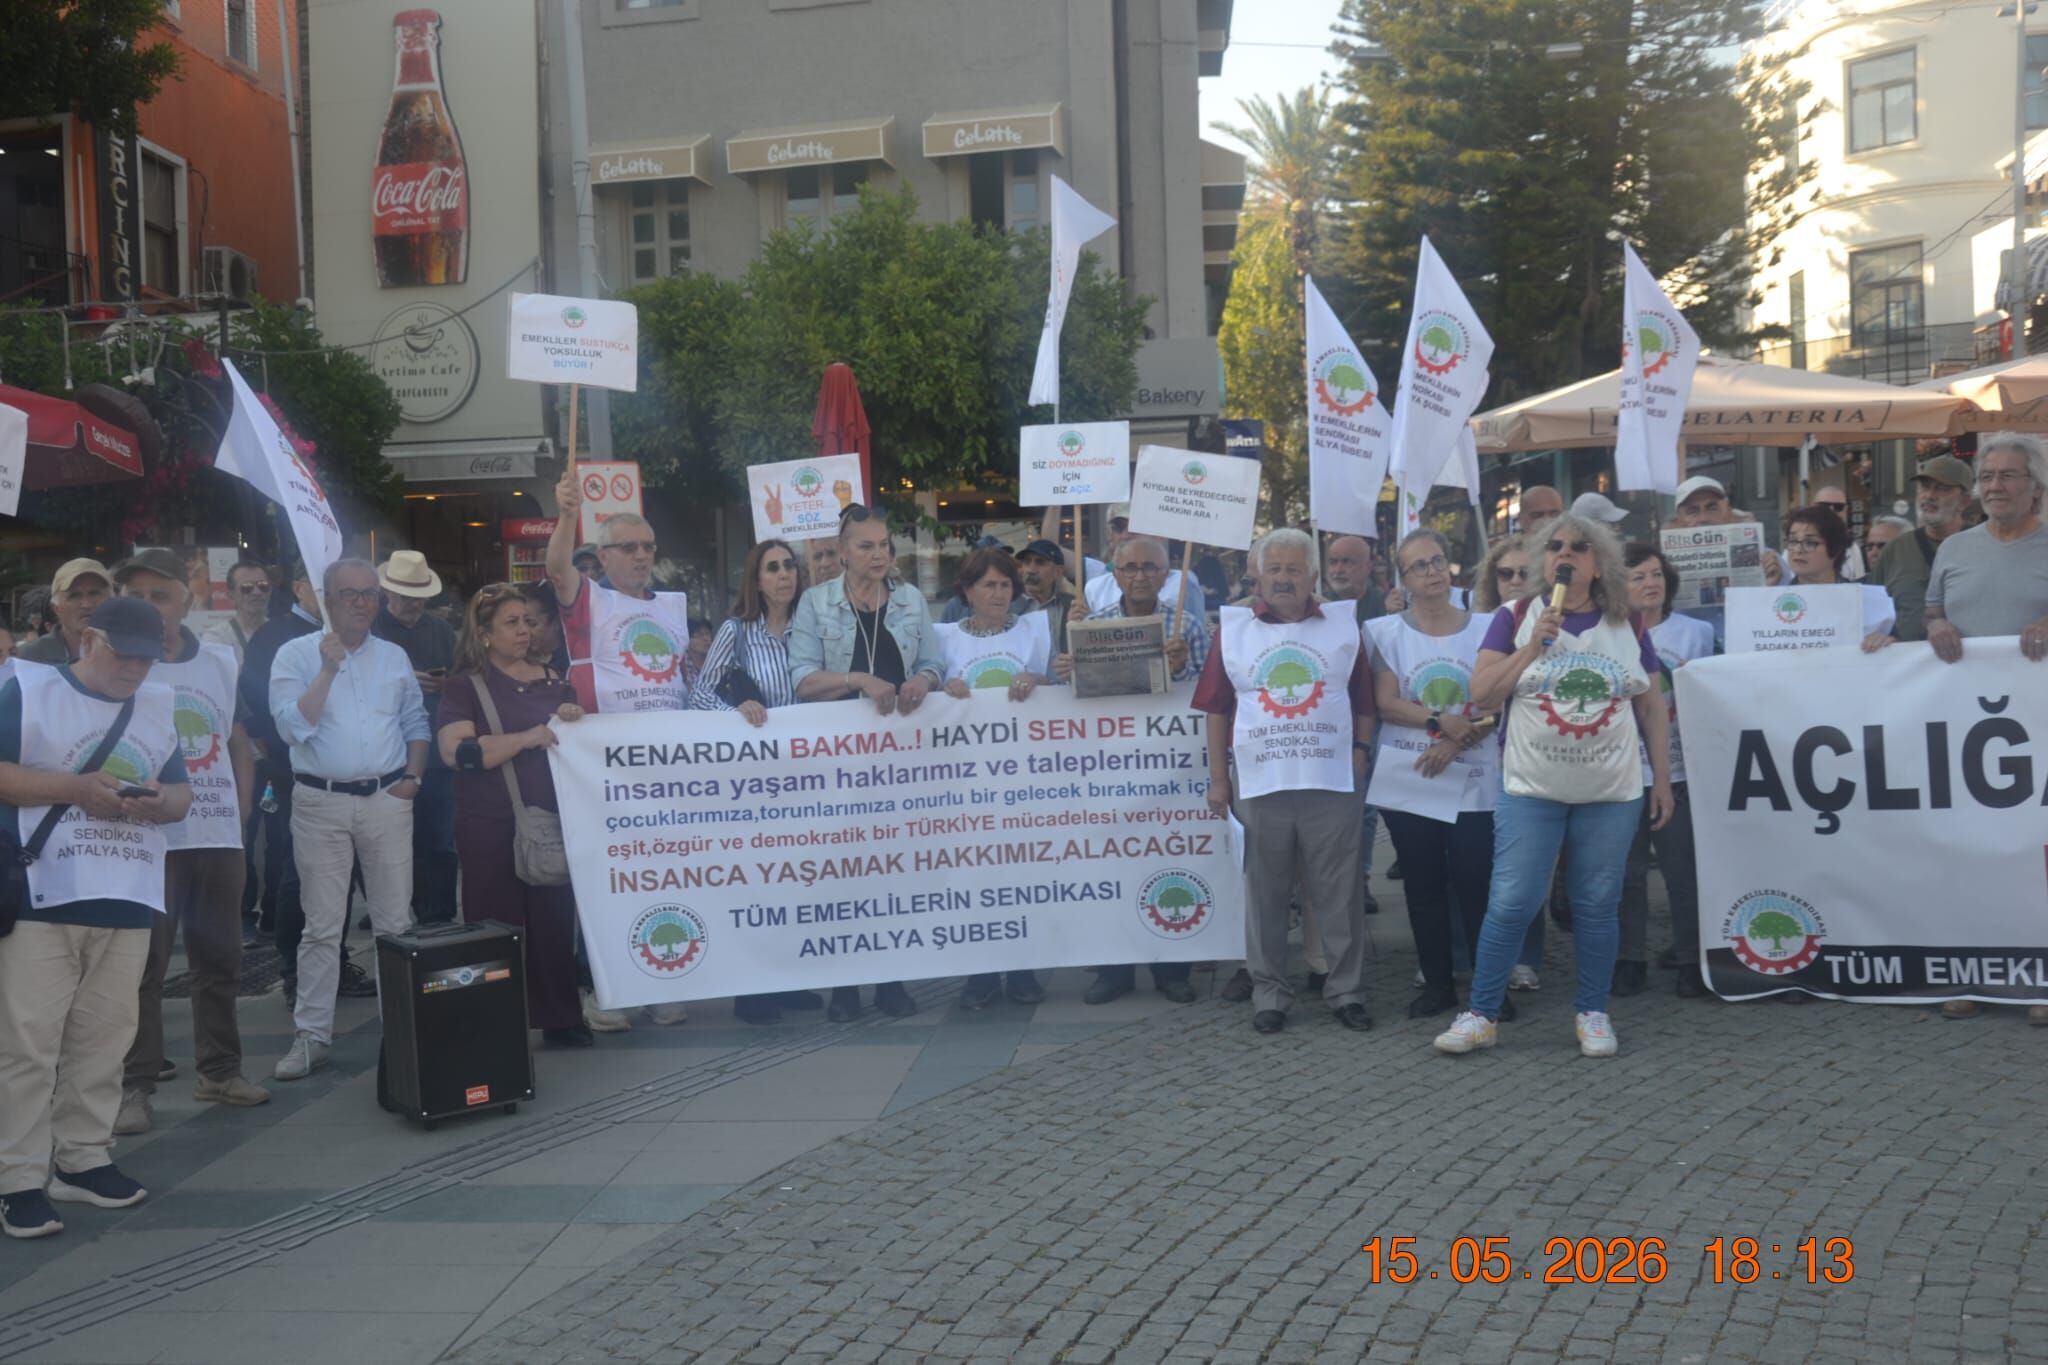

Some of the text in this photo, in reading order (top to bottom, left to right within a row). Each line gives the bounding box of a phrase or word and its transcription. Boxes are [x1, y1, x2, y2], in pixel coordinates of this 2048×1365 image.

[374, 167, 462, 216] Coca-Cola
[522, 334, 576, 346] EMEKLİLER
[544, 347, 602, 359] YOKSULLUK
[431, 363, 461, 376] Cafe
[1138, 388, 1205, 407] Bakery
[470, 455, 513, 474] Coca-Cola
[1062, 471, 1081, 482] İÇİN
[787, 499, 824, 512] YETER
[1164, 495, 1180, 505] GEL
[797, 512, 821, 524] SÖZ
[1194, 509, 1211, 520] ARA
[1752, 627, 1835, 639] YILLARIN EMEĞİ
[1754, 642, 1797, 651] SADAKA
[616, 688, 638, 700] TÜM
[1281, 696, 1299, 705] 2017
[1248, 720, 1338, 739] TÜM EMEKLİLERİN
[605, 739, 779, 768] KENARDAN
[932, 717, 1018, 748] HAYDİ
[1028, 718, 1086, 742] SEN
[1097, 716, 1136, 739] DE
[1146, 713, 1206, 737] KAT
[1265, 736, 1319, 750] SENDİKASI
[1255, 746, 1336, 765] ANTALYA ŞUBESİ
[604, 779, 720, 802] insanca
[730, 772, 825, 801] yaşam
[836, 761, 977, 790] haklarımız
[986, 757, 1018, 776] ve
[1028, 747, 1193, 777] taleplerimiz
[902, 790, 963, 811] onurlu
[970, 787, 999, 805] bir
[1004, 780, 1081, 806] gelecek
[1088, 778, 1181, 799] bırakmak
[1187, 777, 1211, 798] içi
[74, 828, 144, 844] SENDİKASI
[607, 836, 712, 861] eşit,özgür
[719, 835, 743, 851] ve
[750, 826, 866, 850] demokratik
[873, 823, 900, 841] bir
[906, 811, 996, 838] TÜRKİYE
[1002, 807, 1117, 831] mücadelesi
[57, 844, 119, 860] ANTALYA
[609, 863, 748, 894] İNSANCA
[757, 852, 905, 887] YAŞAMAK
[729, 880, 1122, 928] TÜM EMEKLİLERİN SENDİKASI
[1728, 888, 1788, 917] EMEKLİLERİN
[1790, 894, 1828, 938] SENDİKASI
[800, 915, 1027, 958] ANTALYA ŞUBESİ
[661, 952, 680, 961] 2017
[1824, 951, 1903, 985] TÜM
